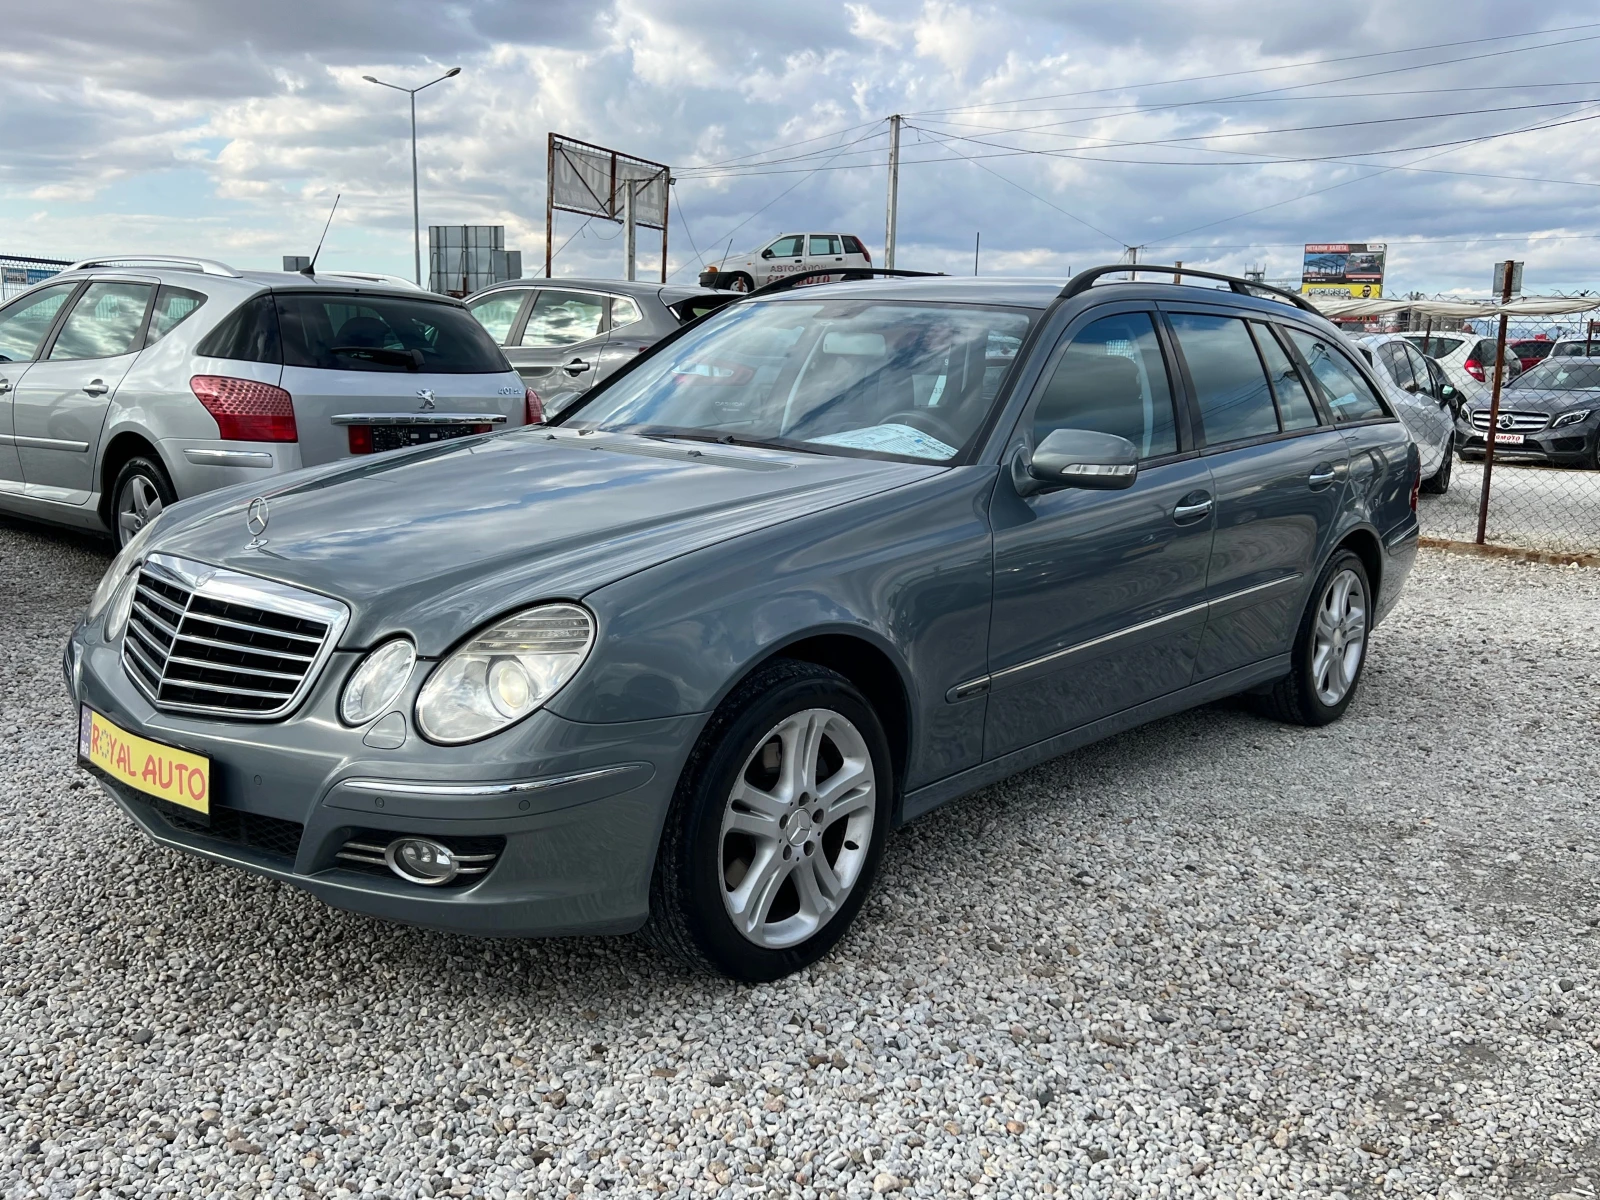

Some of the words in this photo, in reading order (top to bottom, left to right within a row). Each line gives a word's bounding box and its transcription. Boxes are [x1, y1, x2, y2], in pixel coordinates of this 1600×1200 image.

[80, 739, 89, 755] BG
[91, 723, 137, 777] ROYAL
[141, 754, 206, 801] AUTO
